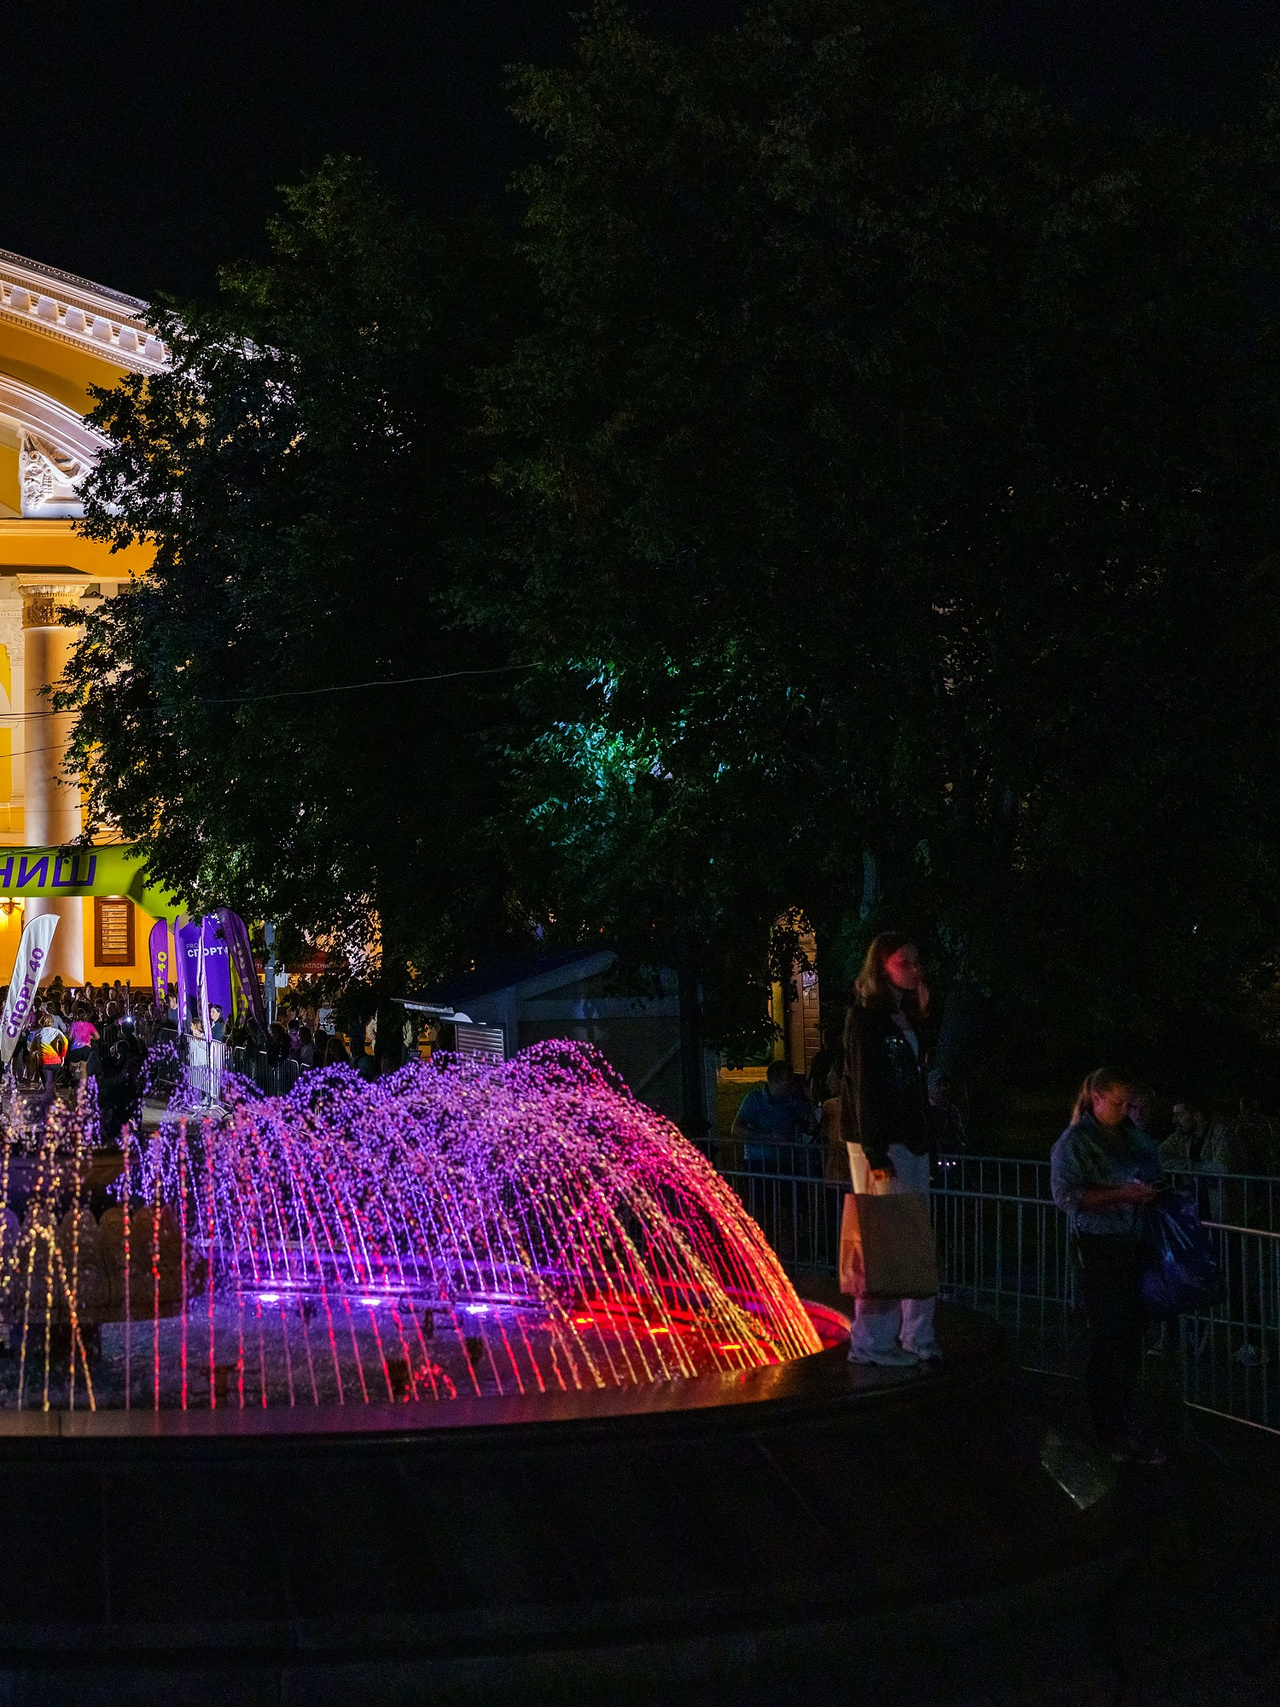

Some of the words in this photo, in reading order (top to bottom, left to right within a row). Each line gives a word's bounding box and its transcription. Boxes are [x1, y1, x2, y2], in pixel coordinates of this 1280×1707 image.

[157, 951, 168, 973] 40
[6, 973, 36, 1038] СПОРТ
[29, 947, 44, 973] 40
